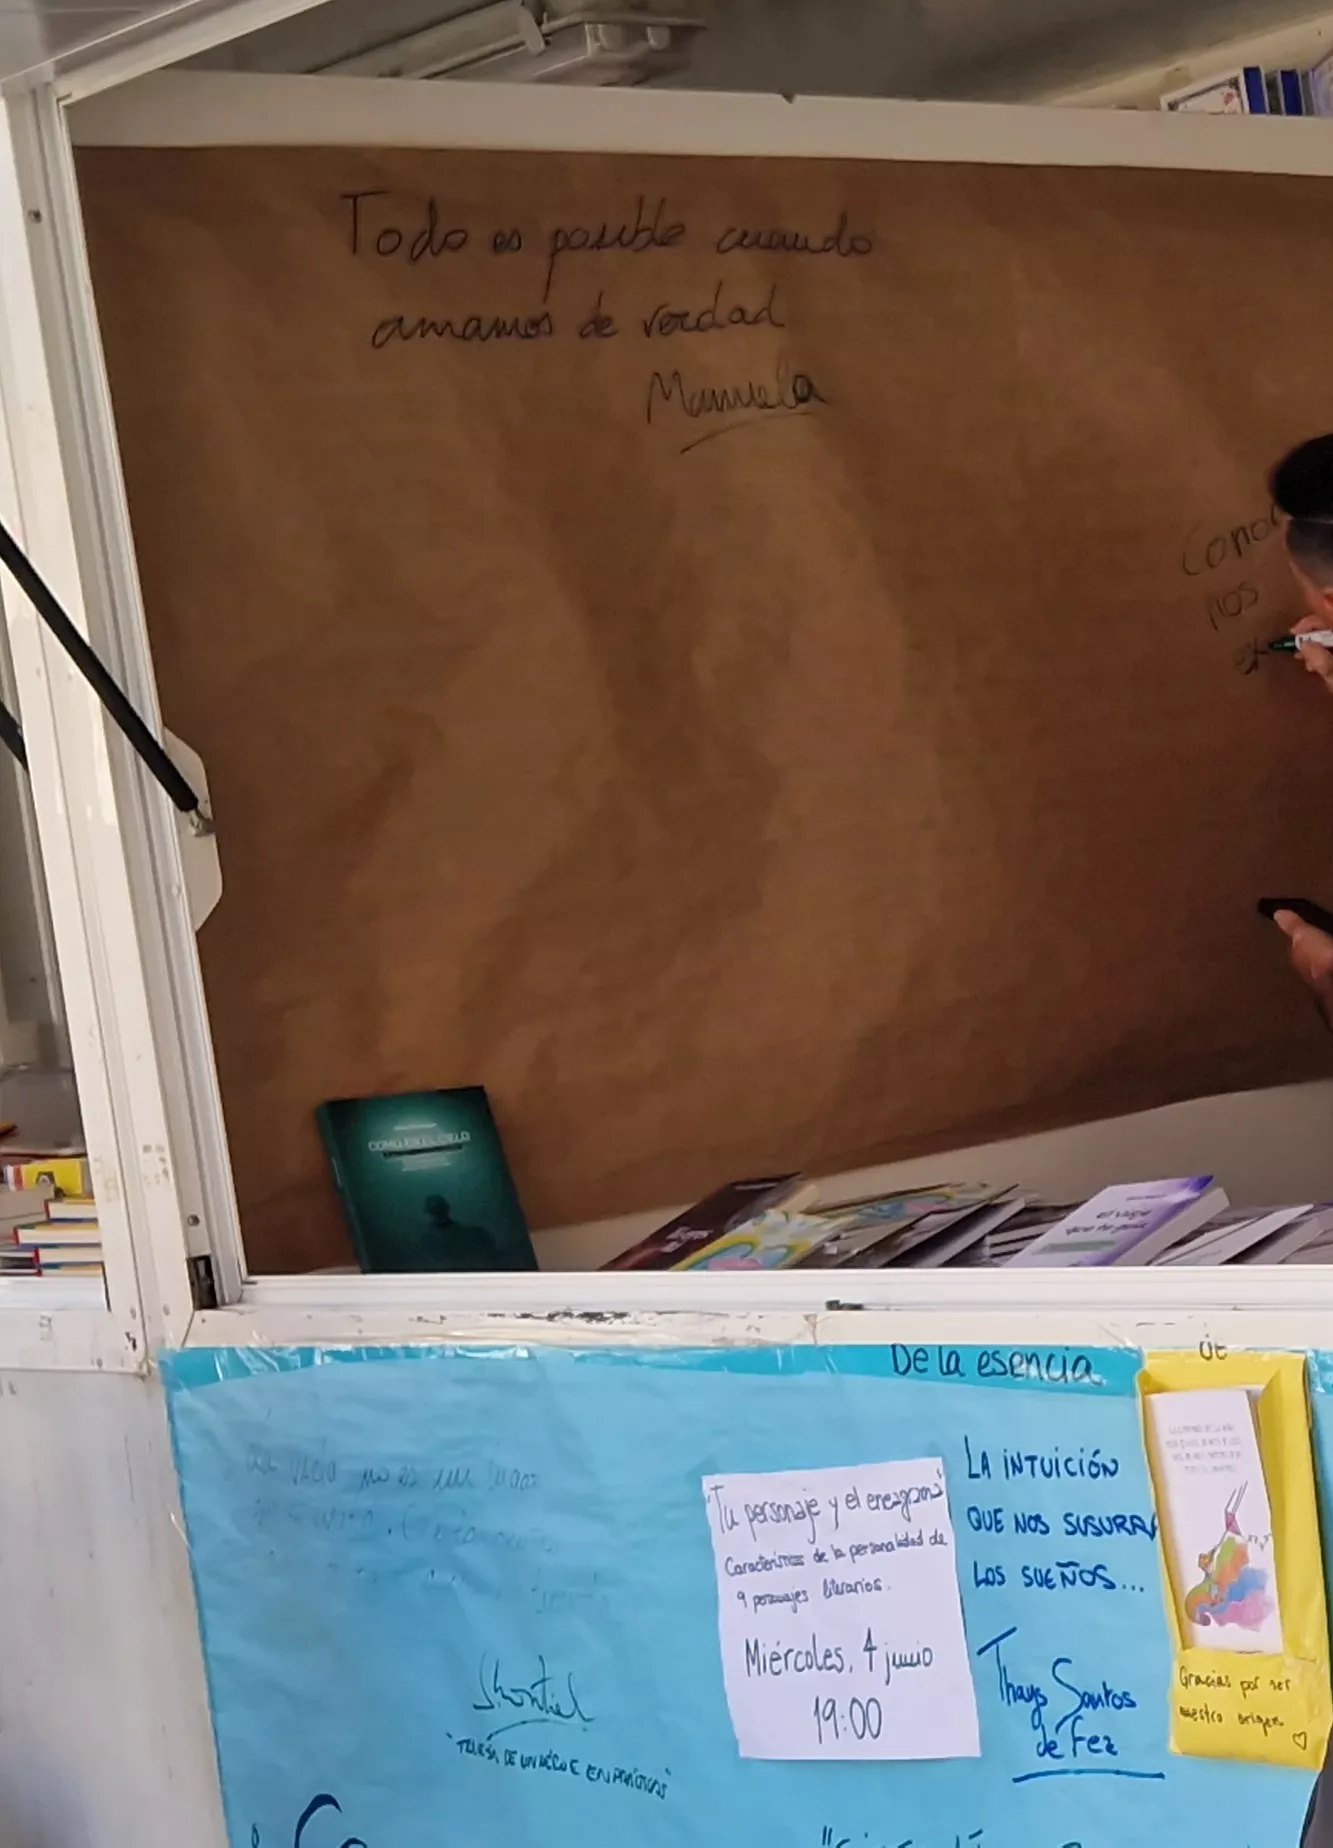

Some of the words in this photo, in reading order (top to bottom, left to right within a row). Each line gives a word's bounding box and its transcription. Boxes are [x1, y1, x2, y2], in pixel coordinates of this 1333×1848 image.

[341, 190, 468, 264] Todo
[889, 1342, 929, 1376] De
[938, 1345, 966, 1377] la
[976, 1346, 1107, 1387] esencia
[964, 1435, 991, 1480] LA
[744, 1488, 822, 1545] personaje
[830, 1496, 840, 1531] y
[845, 1486, 861, 1510] el
[966, 1506, 1005, 1534] QUE
[1014, 1511, 1050, 1535] NOS
[812, 1547, 829, 1563] de
[928, 1527, 949, 1547] de
[973, 1560, 1007, 1589] LOS
[862, 1626, 878, 1673] 4
[883, 1640, 934, 1686] junio
[1051, 1657, 1137, 1735] Santos
[1179, 1665, 1232, 1690] Gracias
[1239, 1675, 1260, 1700] por
[813, 1695, 883, 1744] 19:00
[1036, 1723, 1065, 1760] de
